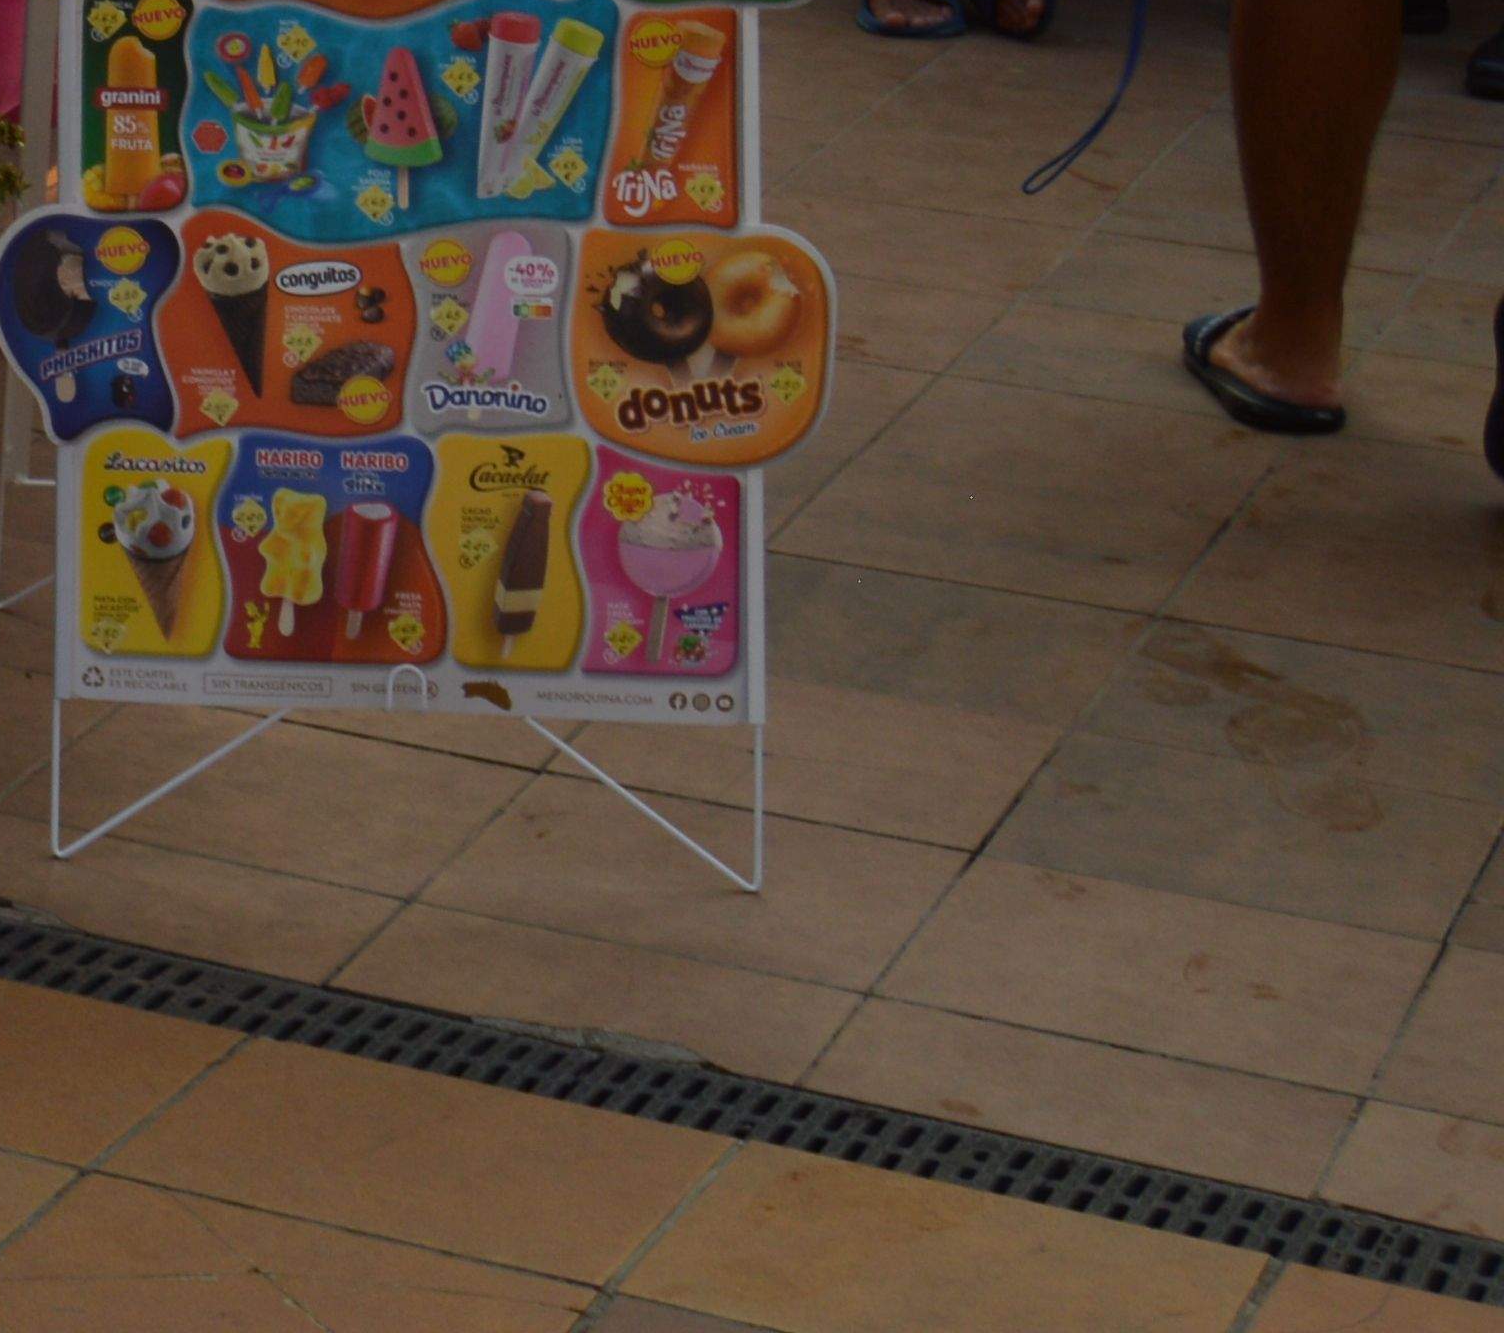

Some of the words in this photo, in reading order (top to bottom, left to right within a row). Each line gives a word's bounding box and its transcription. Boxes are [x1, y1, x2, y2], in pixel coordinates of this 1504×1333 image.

[132, 6, 188, 25] NUEVO
[629, 33, 682, 50] NUEVO
[100, 89, 161, 107] granini
[110, 137, 153, 151] FRUTA
[96, 242, 151, 259] NUEVO
[650, 250, 704, 268] NUEVO
[419, 253, 473, 271] NUEVO
[279, 265, 357, 290] conguitos
[41, 330, 143, 380] PHOSKITOS
[339, 391, 391, 407] NUEVO
[425, 382, 548, 414] Danonino
[617, 379, 763, 430] donuts
[103, 450, 207, 475] Lacasitos
[256, 448, 324, 468] HARIBO
[341, 450, 410, 471] HARIBO
[468, 462, 551, 492] Cacaolat
[537, 690, 654, 706] MENORQUINA.COM
